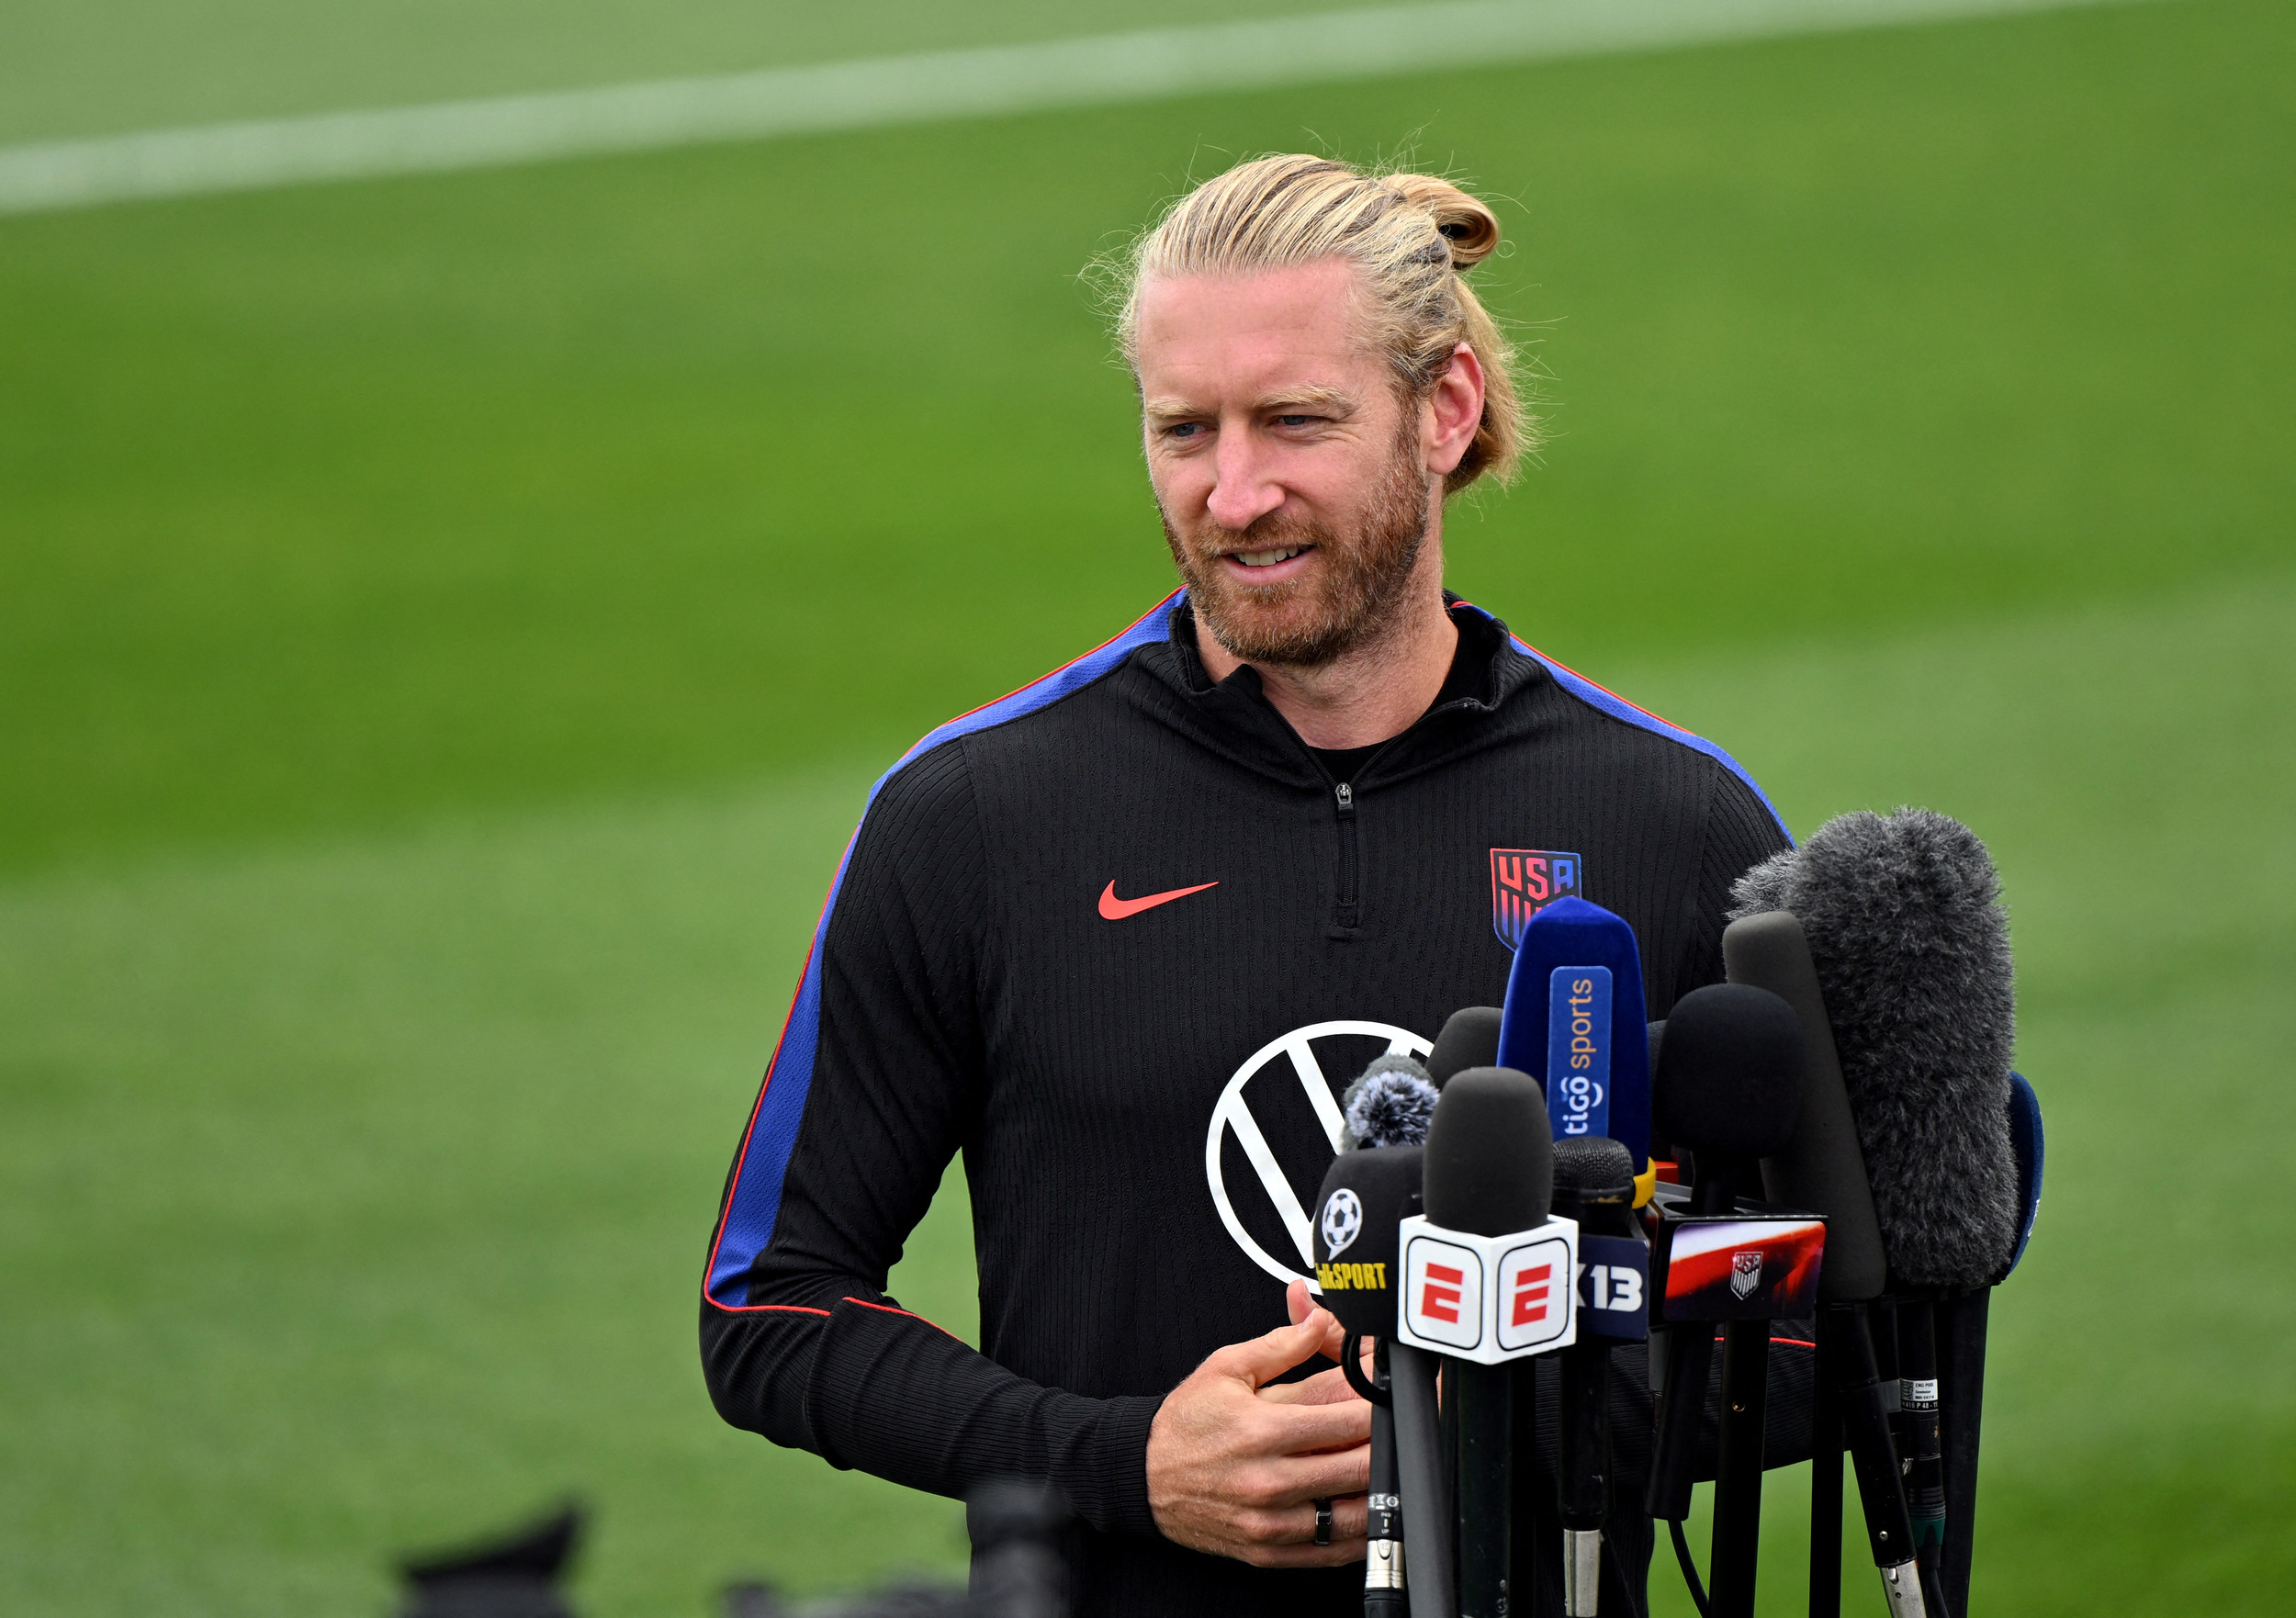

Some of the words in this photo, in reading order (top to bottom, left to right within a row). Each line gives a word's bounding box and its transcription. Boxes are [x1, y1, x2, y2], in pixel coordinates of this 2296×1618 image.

[1498, 855, 1574, 901] USA
[1569, 979, 1597, 1070] sports
[1421, 1262, 1463, 1324] E
[1735, 1254, 1761, 1273] USA
[1512, 1264, 1552, 1327] E
